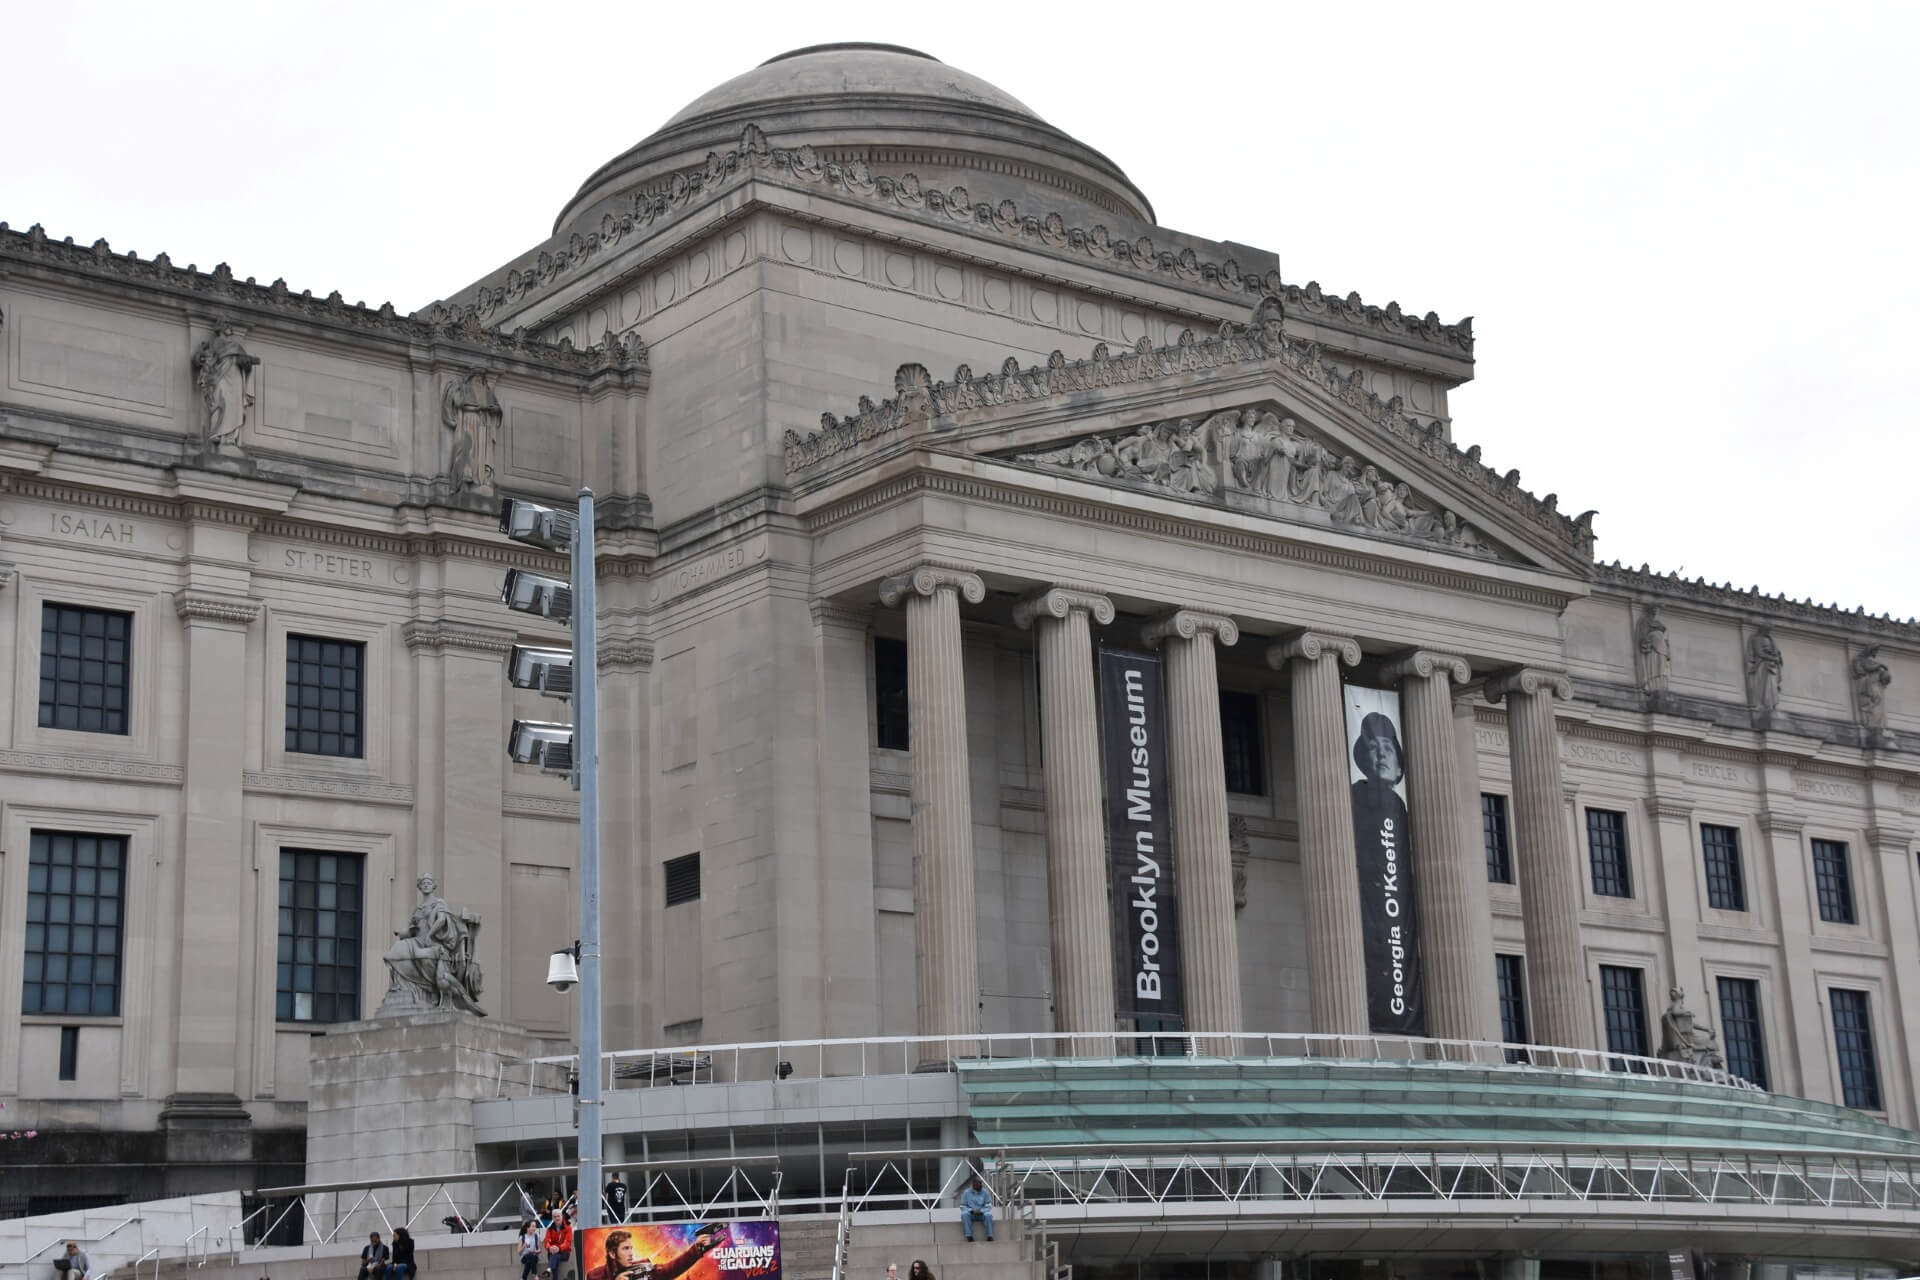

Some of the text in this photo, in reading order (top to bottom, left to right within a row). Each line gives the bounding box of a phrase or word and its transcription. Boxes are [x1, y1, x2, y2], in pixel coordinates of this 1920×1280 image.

[50, 512, 135, 544] ISAIAH
[313, 552, 374, 579] PETER
[671, 547, 745, 593] MOHAMMED
[1569, 743, 1633, 766] SOPHOCLES
[1691, 761, 1738, 782] PERICLES
[1124, 669, 1162, 1000] Brooklyn Museum
[1380, 817, 1405, 1016] Georgia O'Keeffe
[712, 1245, 775, 1259] GUARDIANS
[727, 1257, 773, 1270] GALAXY
[769, 1260, 779, 1272] 2
